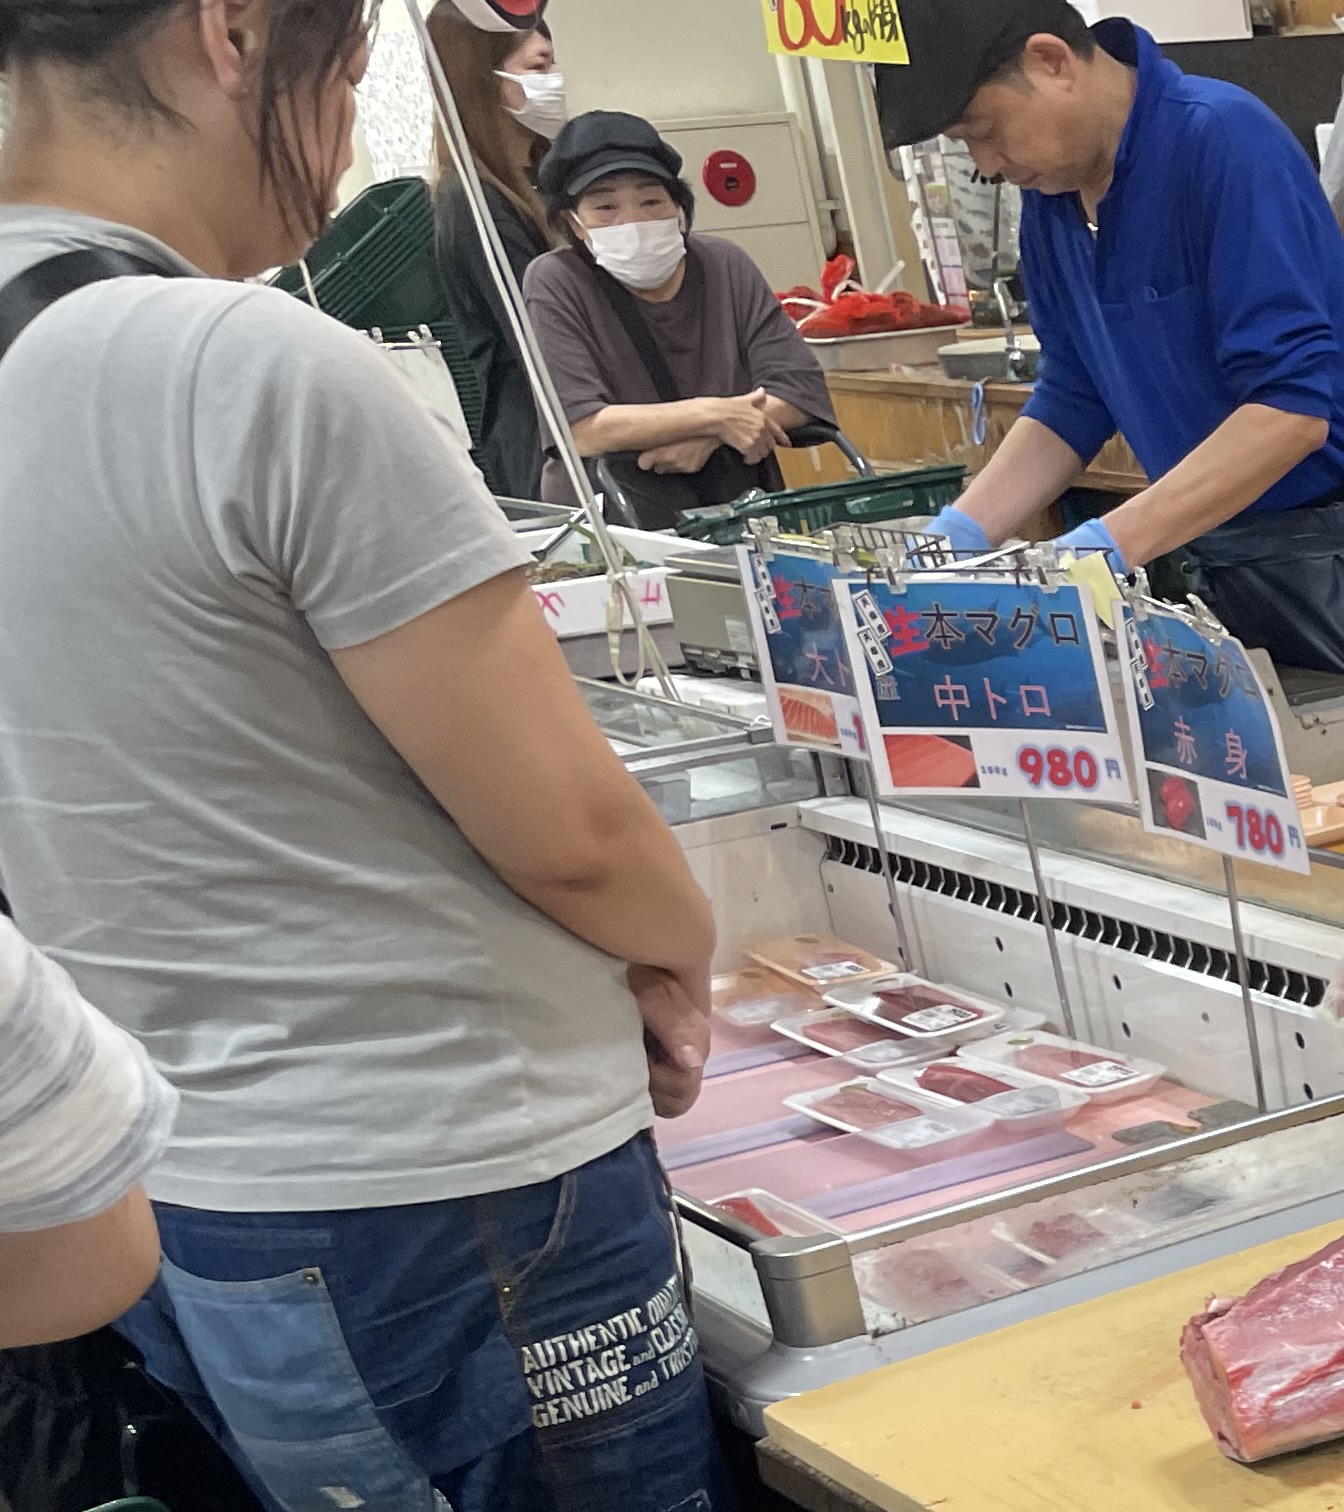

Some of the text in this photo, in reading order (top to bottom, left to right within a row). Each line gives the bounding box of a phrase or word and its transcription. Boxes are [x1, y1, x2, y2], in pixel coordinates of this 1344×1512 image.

[933, 674, 1052, 722] 中トロ
[1018, 747, 1098, 789] 980
[1104, 758, 1121, 779] 円
[1174, 716, 1248, 779] 赤身
[1226, 805, 1284, 855] 780
[521, 1307, 648, 1374] AUTHENTIC
[527, 1344, 632, 1399] VINTAGE
[632, 1341, 657, 1367] and
[531, 1375, 633, 1428] GENUINE
[634, 1370, 660, 1397] and
